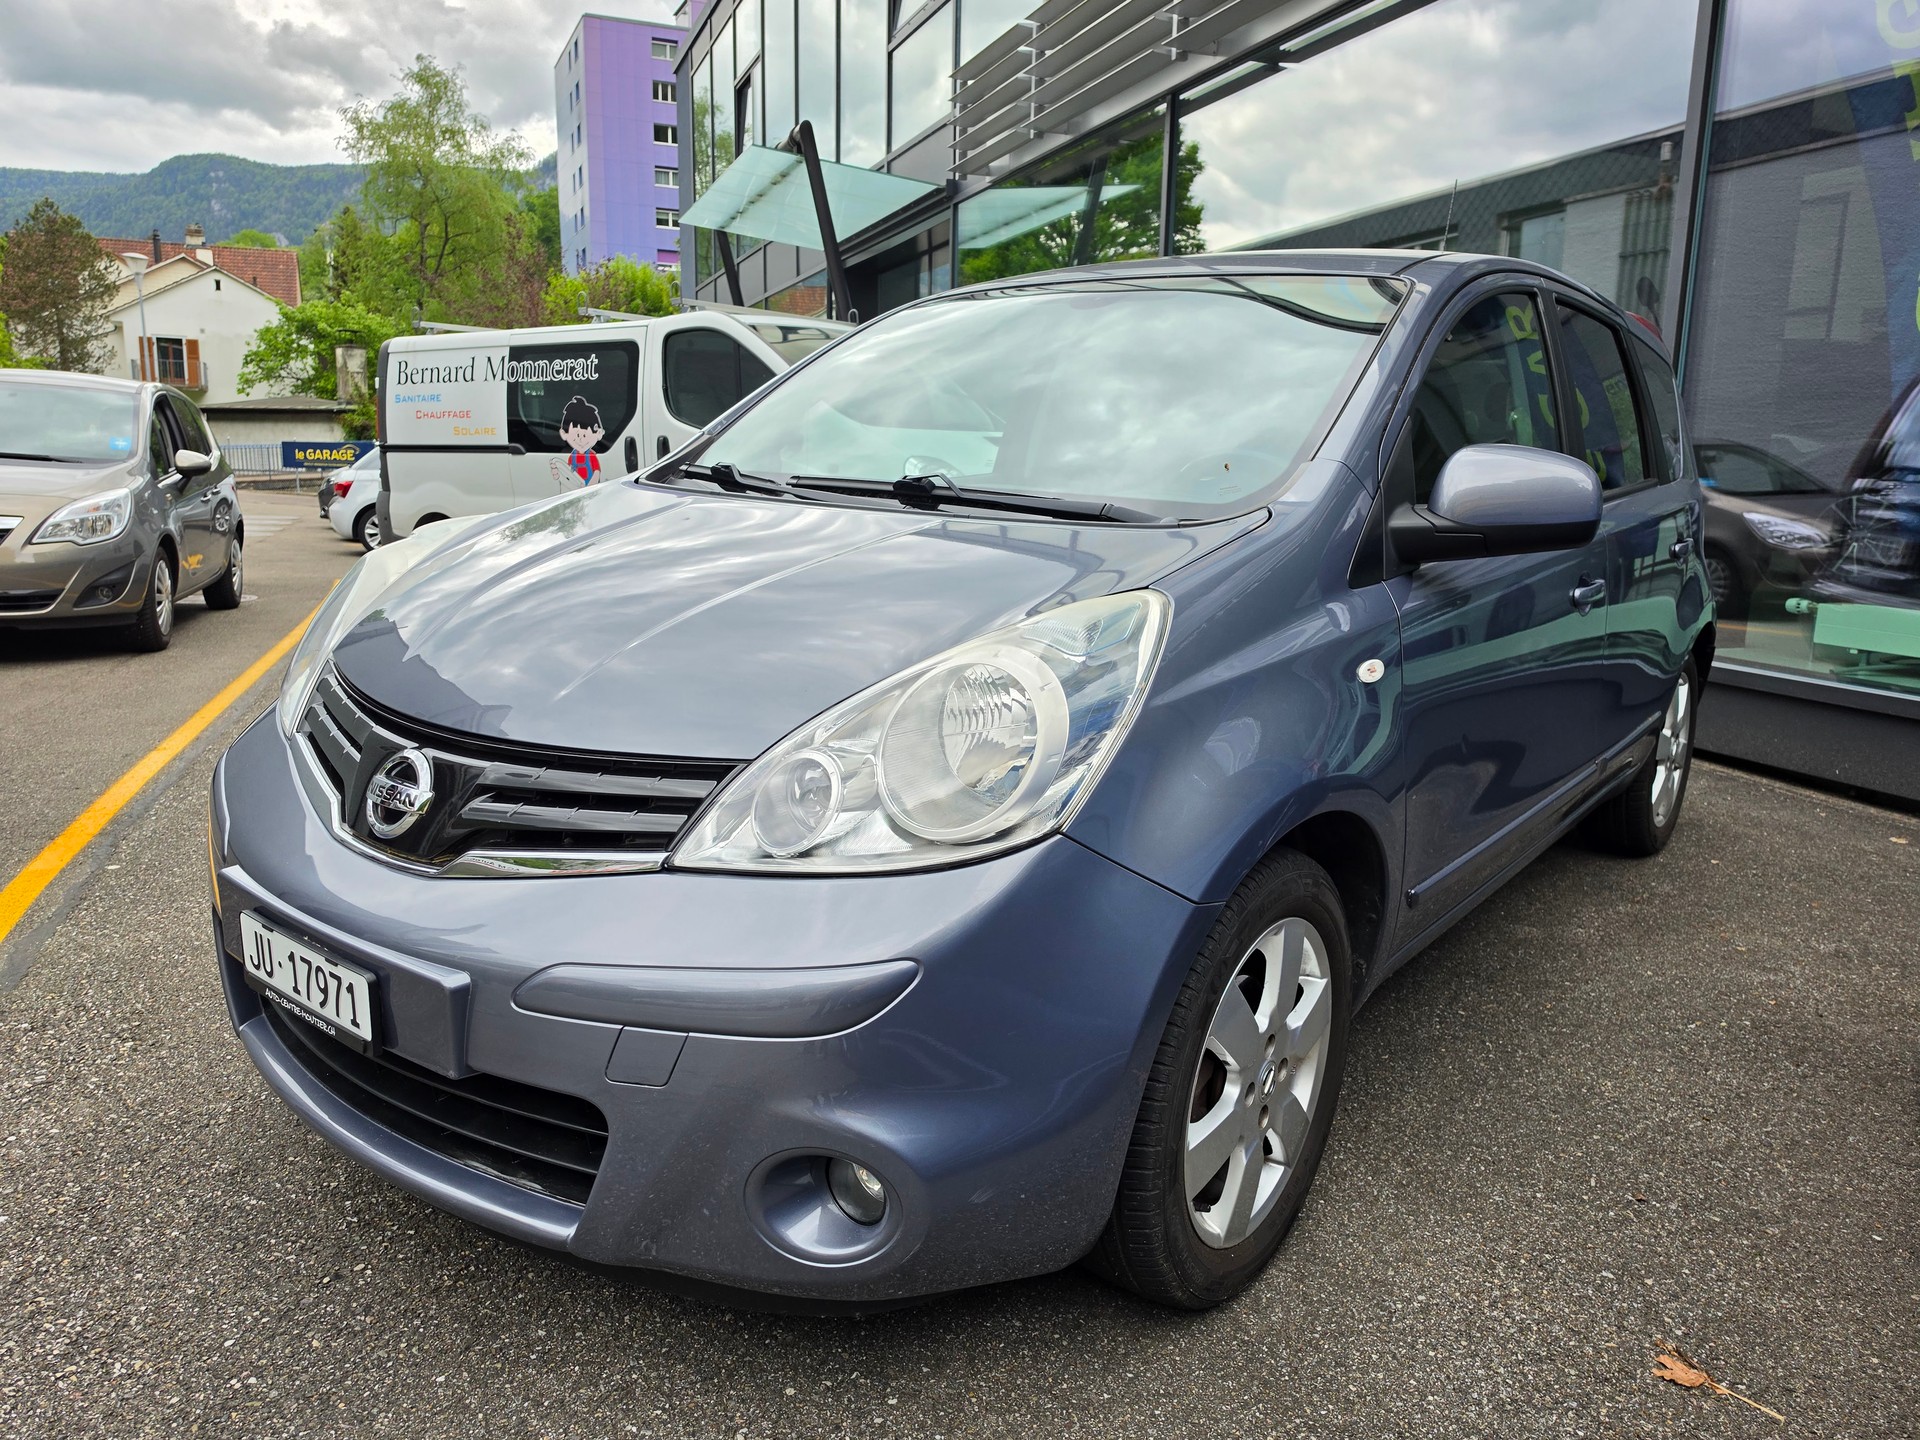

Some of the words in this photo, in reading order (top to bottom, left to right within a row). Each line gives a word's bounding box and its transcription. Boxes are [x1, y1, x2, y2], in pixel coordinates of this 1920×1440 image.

[396, 355, 476, 386] Bernard
[483, 353, 599, 383] Monnerat
[395, 393, 442, 404] SANITAIRE
[415, 409, 471, 420] CHAUFFAGE
[453, 426, 497, 436] SOLAIRE
[295, 448, 305, 460] le
[306, 448, 355, 461] GARAGE
[367, 780, 418, 808] NISSAN
